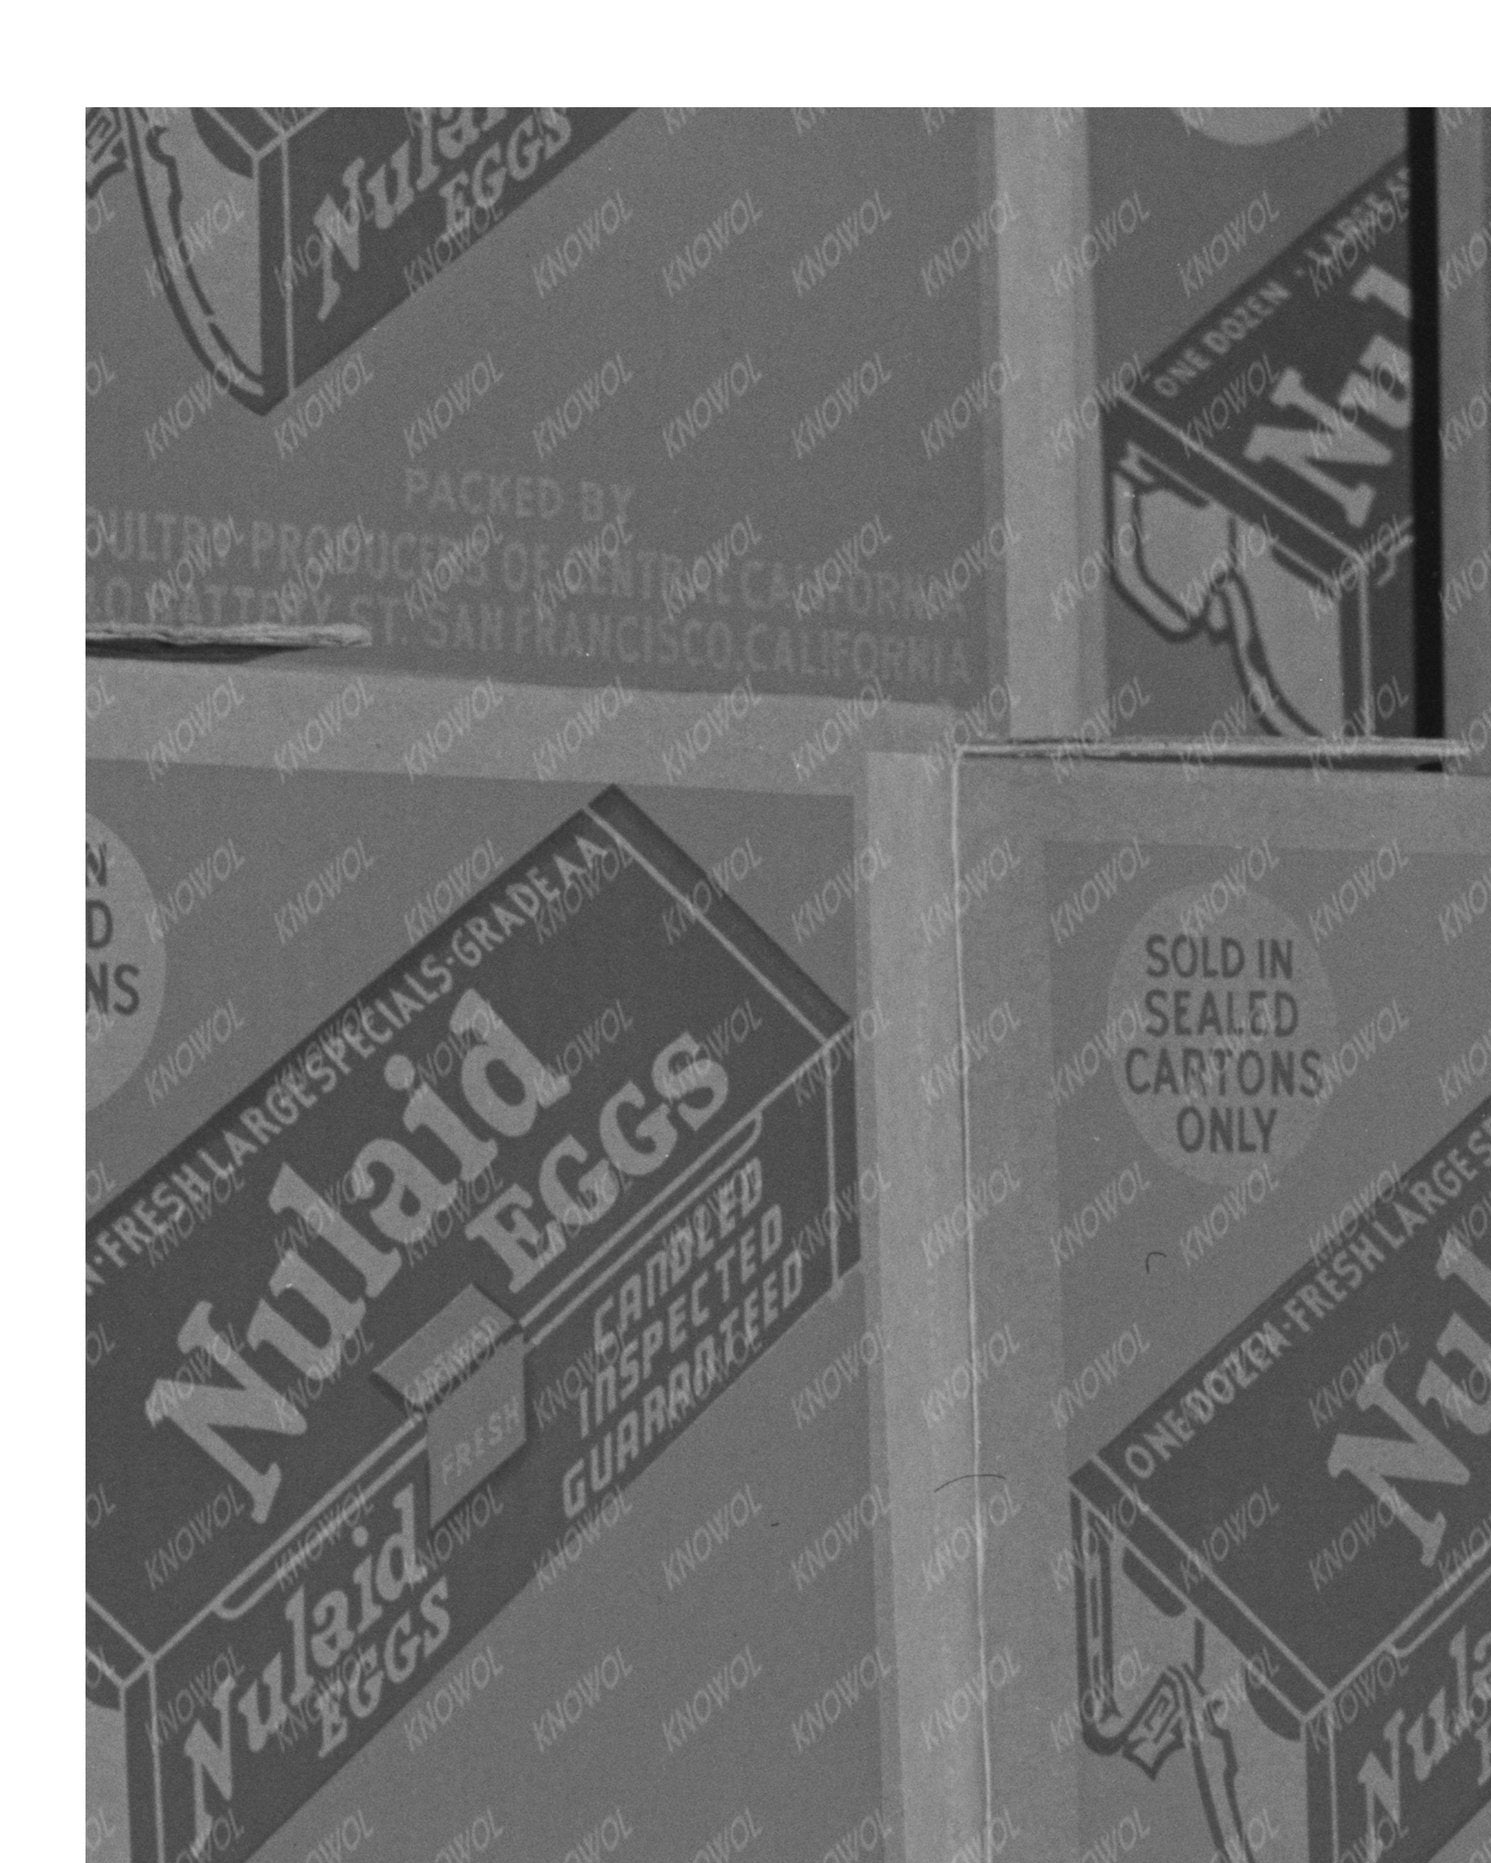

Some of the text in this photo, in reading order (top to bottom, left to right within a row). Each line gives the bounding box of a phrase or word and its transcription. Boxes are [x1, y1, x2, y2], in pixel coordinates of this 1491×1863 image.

[403, 465, 636, 527] PACKED BY
[1143, 988, 1299, 1038] SEALED
[1144, 933, 1294, 981] SOLD IN
[99, 836, 606, 1271] FRESH LARGE SPECIALS GRADE AA
[1123, 1046, 1324, 1098] CARTONS
[1175, 1104, 1278, 1154] ONLY
[464, 1031, 729, 1291] EGGS
[144, 989, 571, 1524] Nulaid
[1122, 1401, 1197, 1467] ONE
[1184, 1322, 1291, 1426] DOZEN
[1299, 1230, 1387, 1337] FRESH
[1374, 1148, 1481, 1251] LARGE
[185, 1481, 427, 1856] Nulaid
[317, 1575, 450, 1759] EGGS
